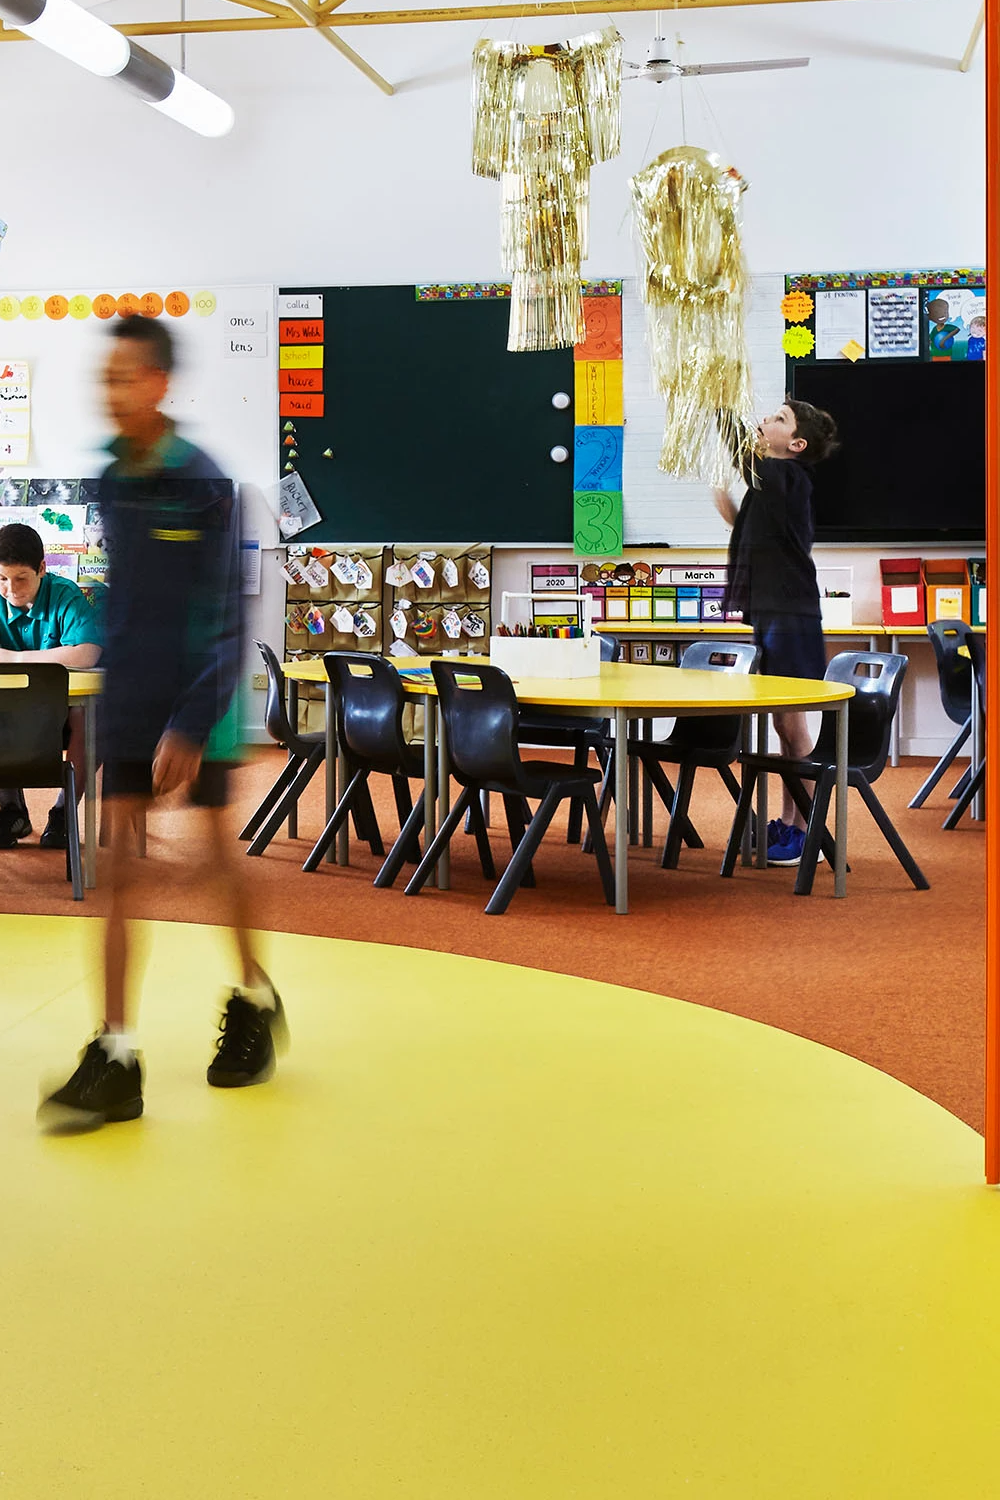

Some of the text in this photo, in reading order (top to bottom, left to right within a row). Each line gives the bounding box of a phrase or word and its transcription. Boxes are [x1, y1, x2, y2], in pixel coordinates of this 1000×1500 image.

[195, 300, 213, 308] 100
[286, 300, 309, 309] called
[171, 304, 182, 315] 90
[230, 317, 255, 326] ones
[286, 327, 300, 338] Mrs
[230, 340, 253, 352] tens
[284, 350, 311, 361] school
[288, 373, 314, 387] have
[289, 399, 312, 409] said
[283, 482, 309, 513] BUCKET
[581, 496, 608, 508] SPEAK
[584, 542, 607, 552] UP!
[684, 571, 715, 579] March
[710, 604, 717, 613] 6
[636, 647, 668, 657] 17 18
